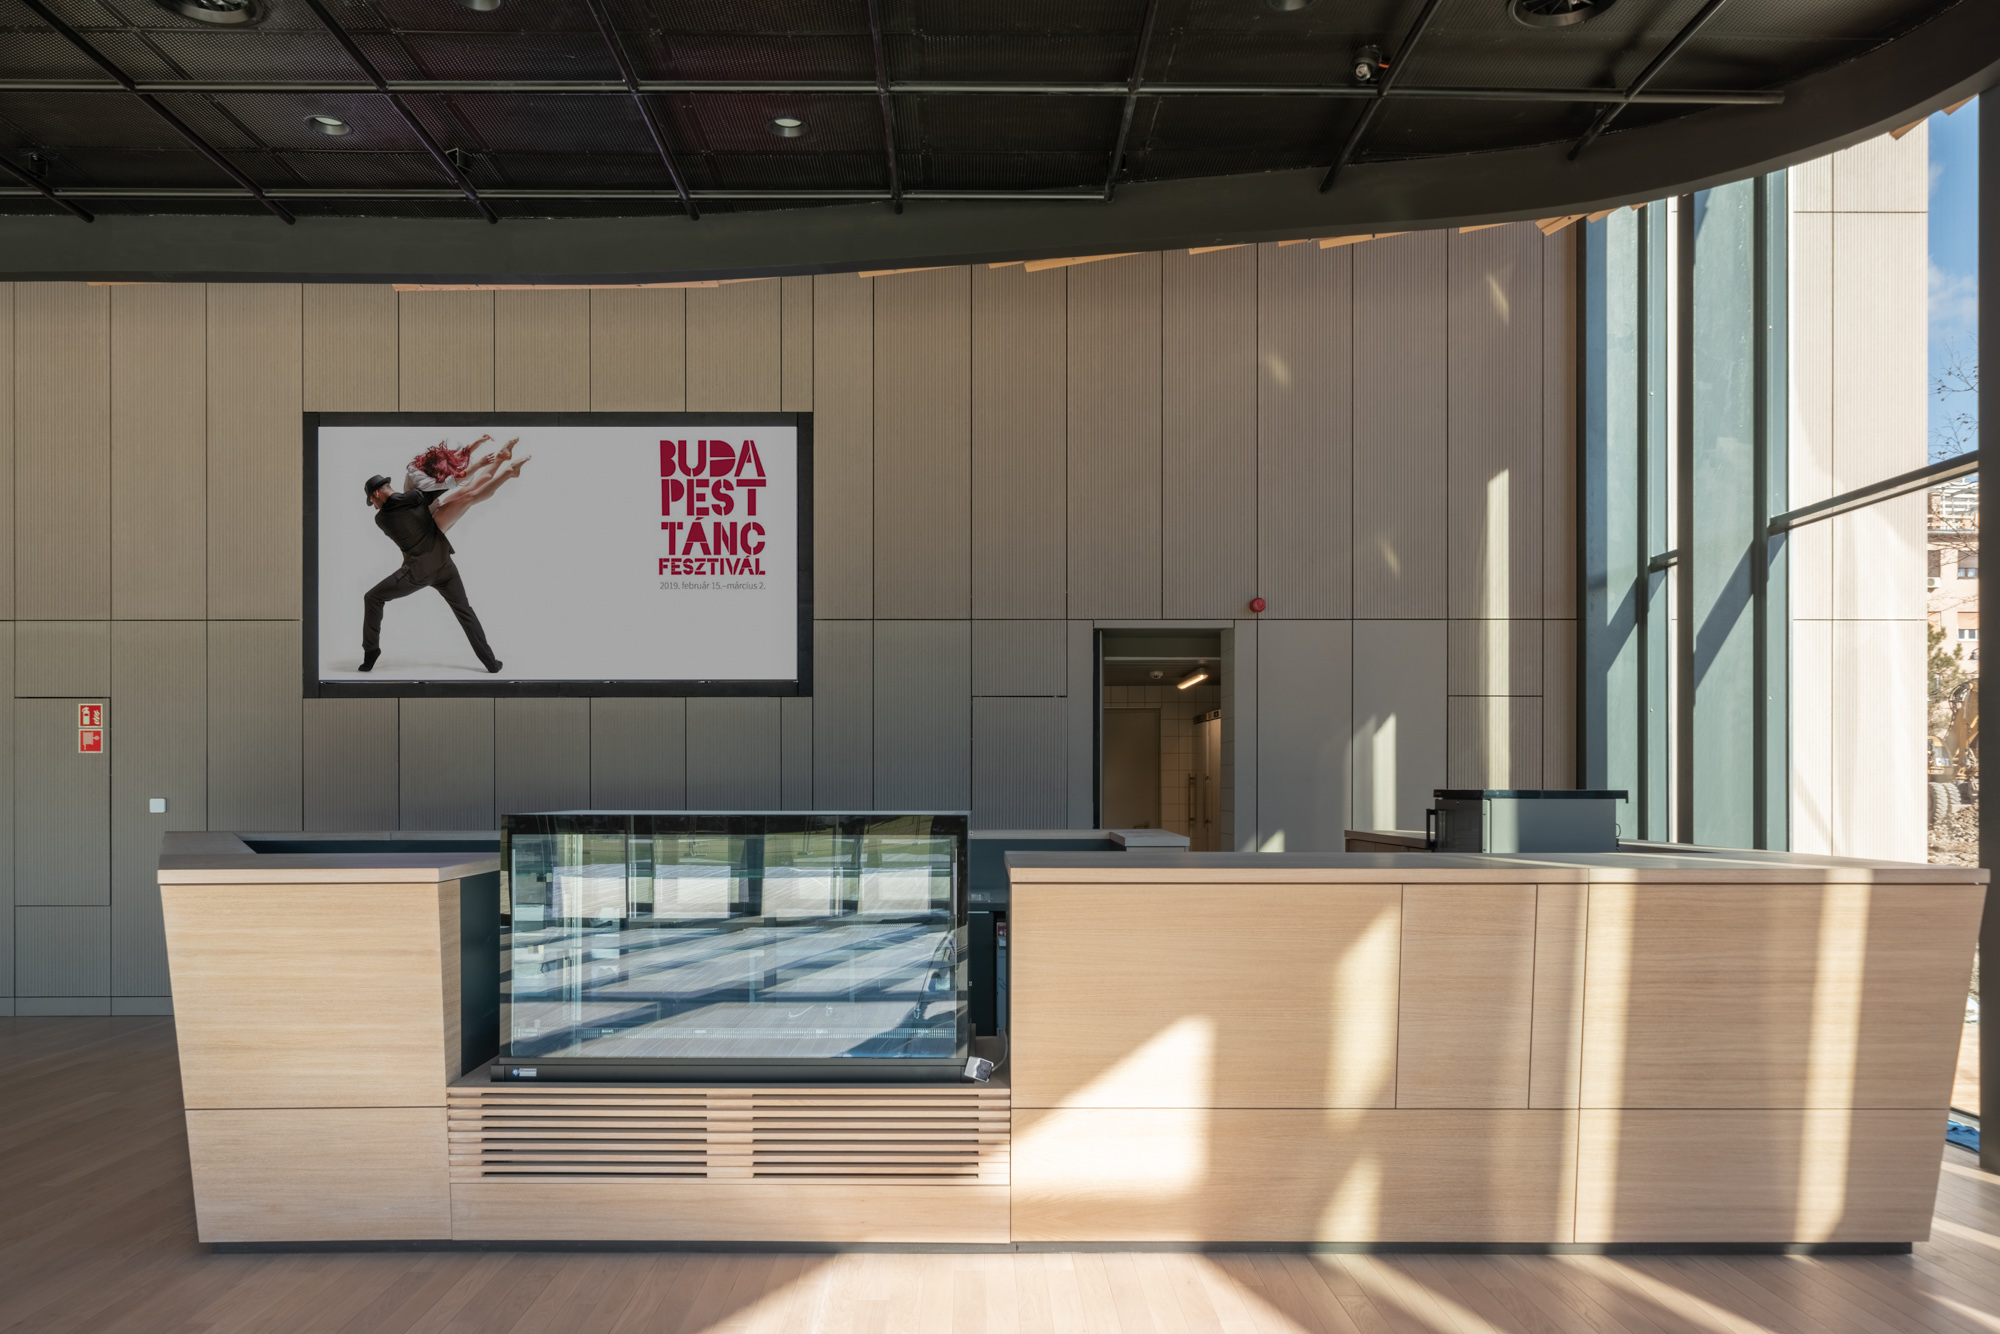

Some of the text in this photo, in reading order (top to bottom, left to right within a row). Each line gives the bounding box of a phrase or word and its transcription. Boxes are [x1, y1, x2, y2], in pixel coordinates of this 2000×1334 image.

[660, 440, 766, 477] BUDA
[661, 479, 767, 516] PEST
[661, 517, 766, 555] TÁNC
[659, 556, 766, 575] FESZTIVÁL
[660, 582, 680, 590] 2019.
[682, 581, 710, 590] február
[759, 582, 766, 590] 2.
